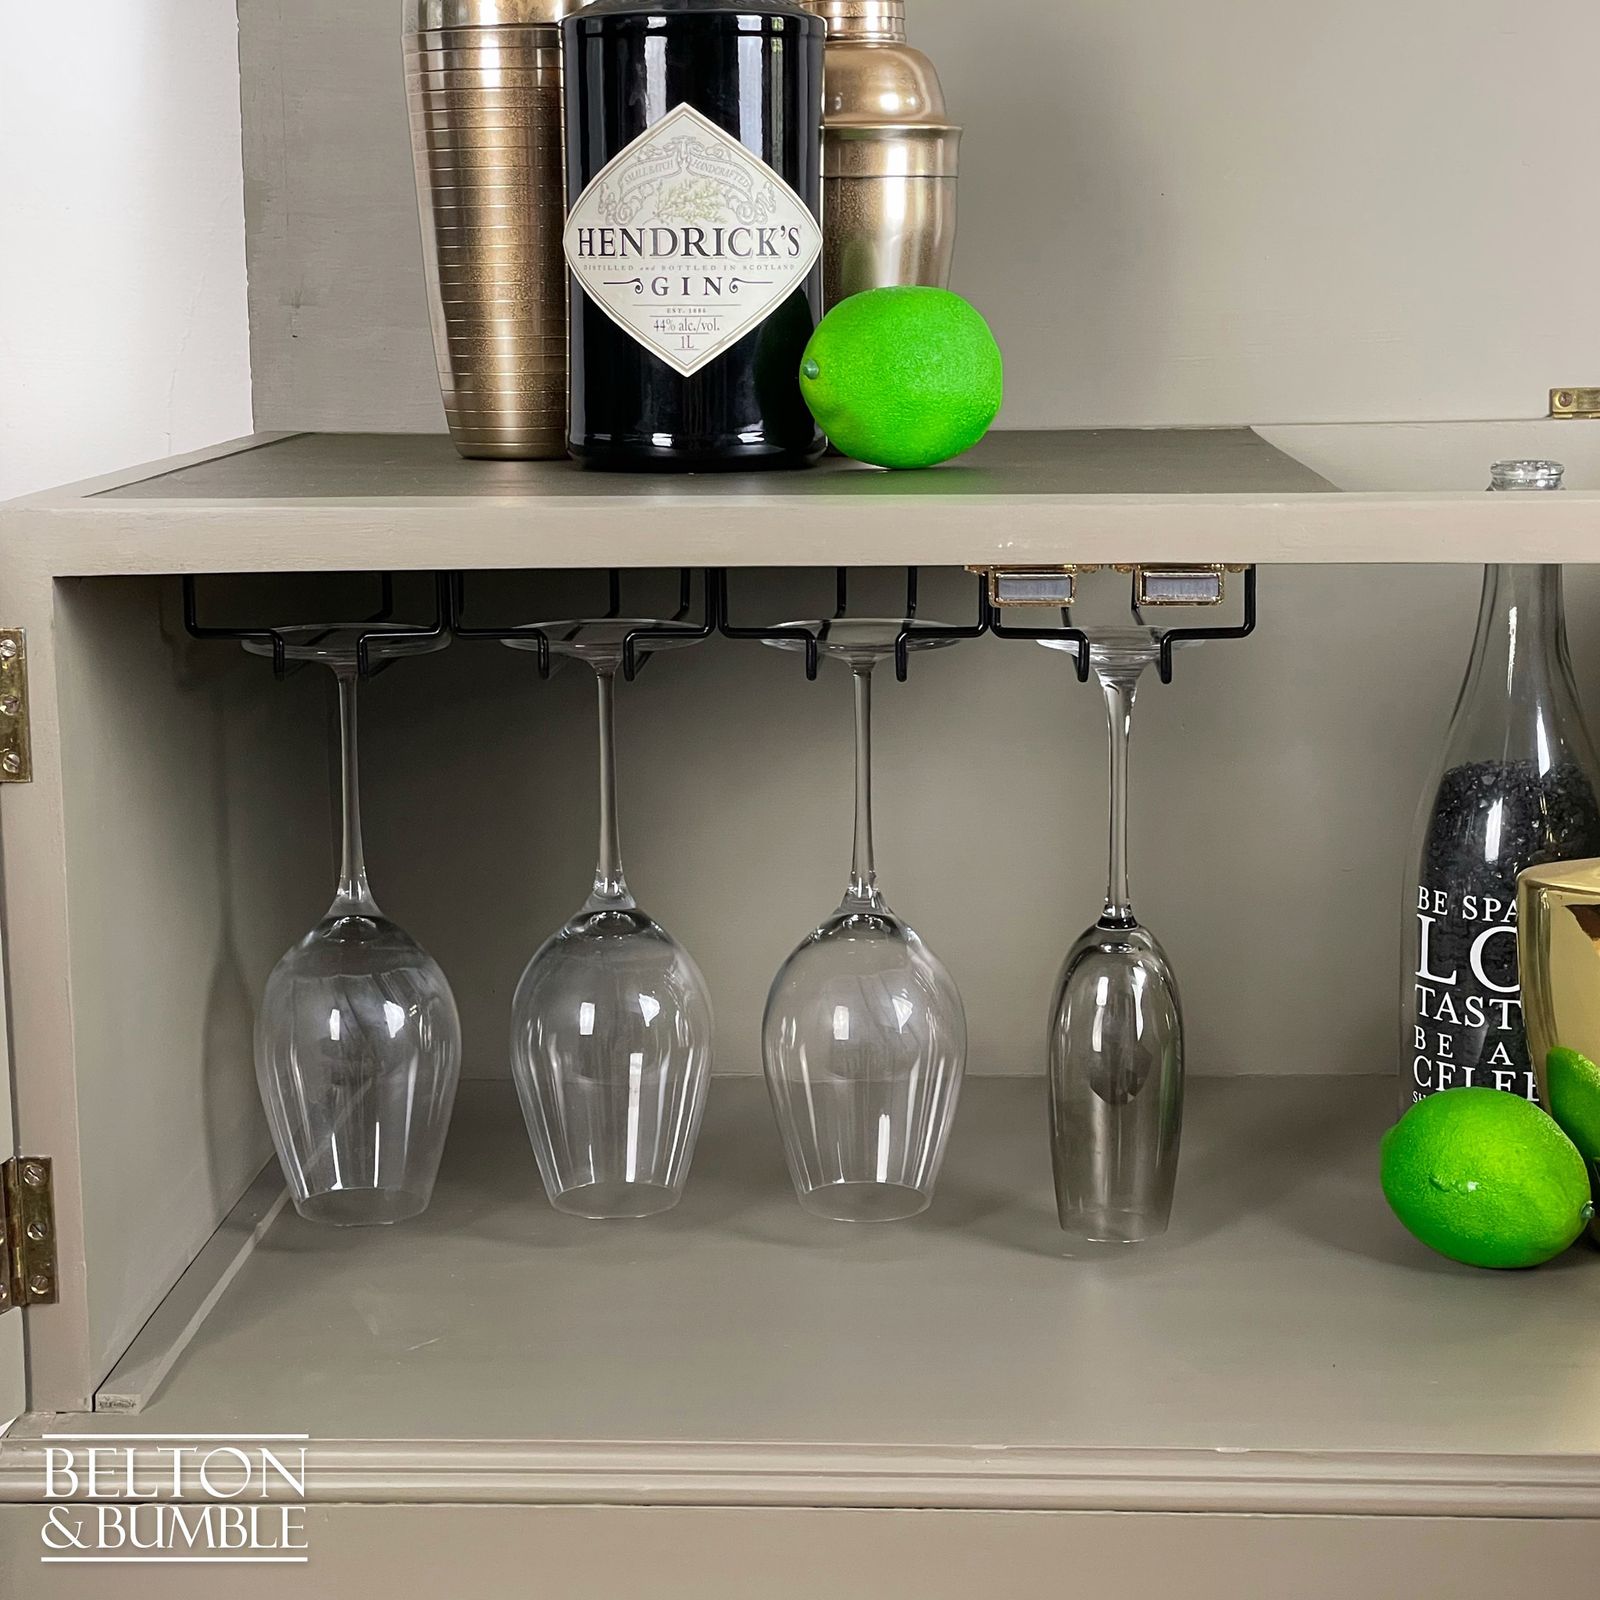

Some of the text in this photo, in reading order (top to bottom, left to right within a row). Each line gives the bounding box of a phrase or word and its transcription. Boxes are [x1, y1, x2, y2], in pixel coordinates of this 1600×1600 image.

[577, 226, 801, 258] HENDRICK'S
[651, 276, 723, 297] GIN
[653, 317, 721, 333] 44% alc./vol.
[681, 335, 695, 349] 1L
[1417, 886, 1448, 916] BE
[1414, 983, 1522, 1030] TAST
[1414, 1024, 1514, 1066] BE A
